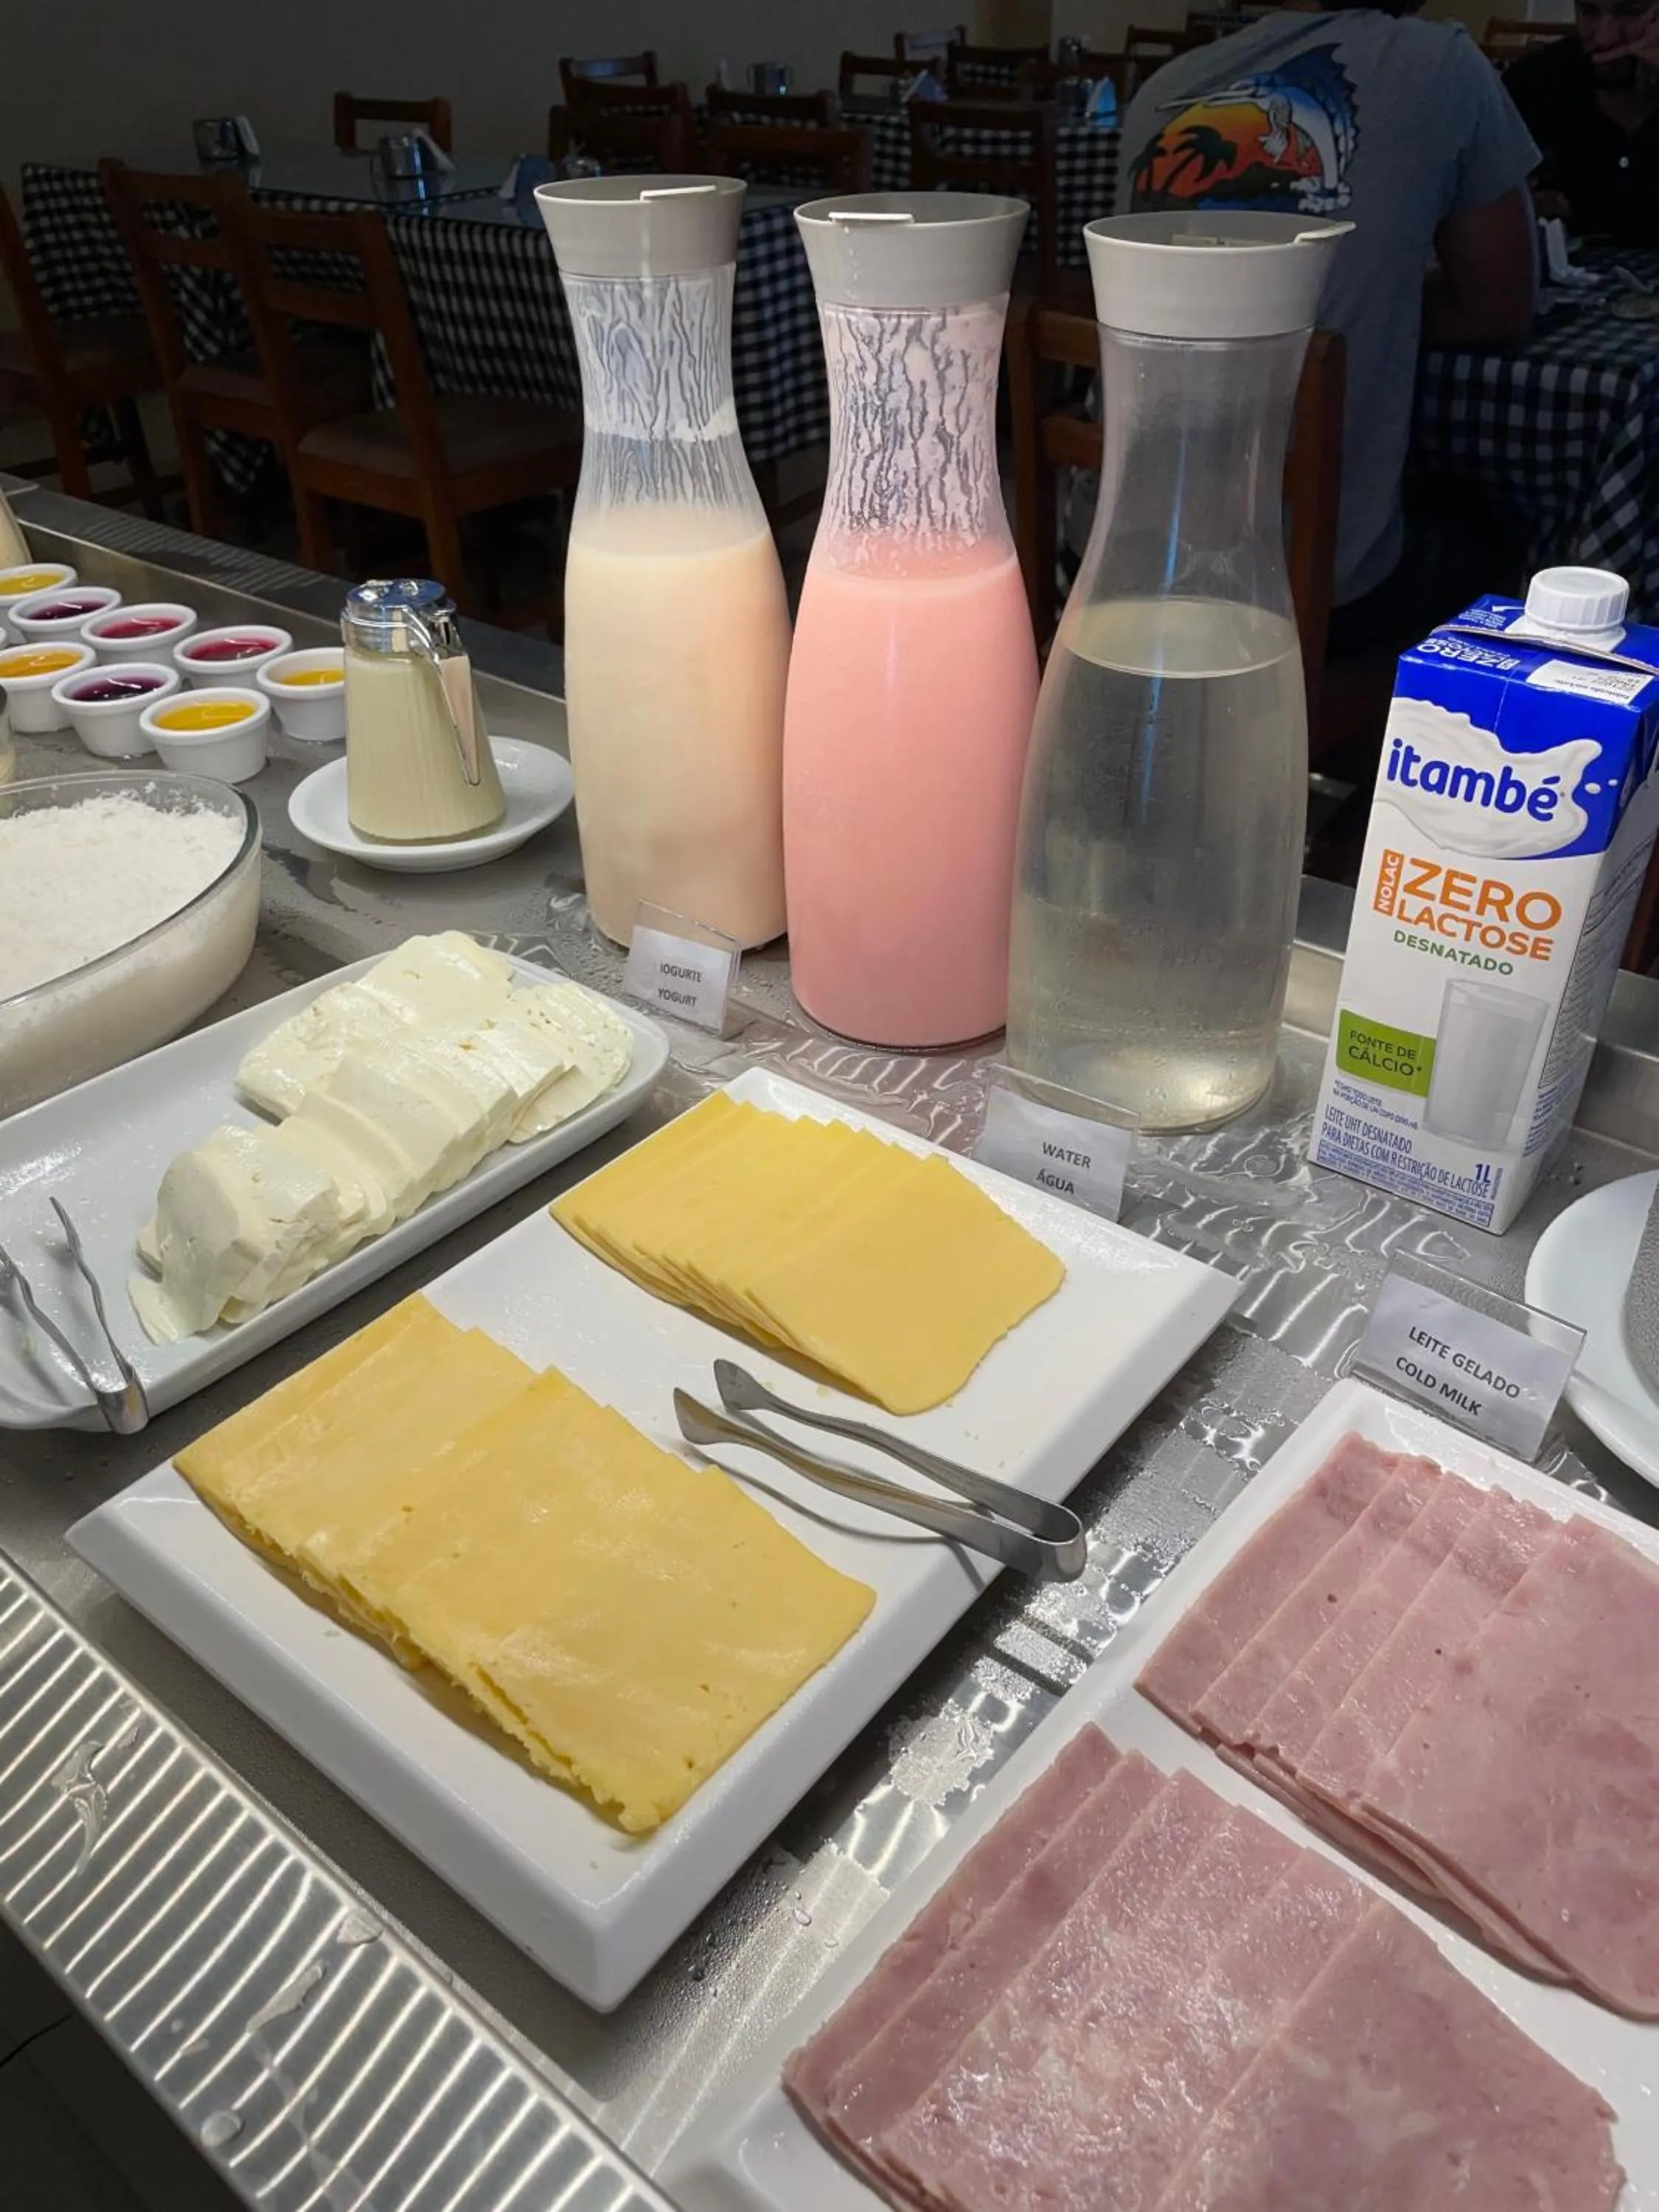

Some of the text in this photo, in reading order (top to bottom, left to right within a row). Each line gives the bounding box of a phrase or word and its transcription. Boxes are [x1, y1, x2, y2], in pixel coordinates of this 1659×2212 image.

[1386, 738, 1561, 821] itambé
[1377, 853, 1401, 911] NOLAC
[1403, 858, 1562, 931] ZERO
[1394, 929, 1514, 976] DESNATADO
[1397, 899, 1554, 961] LACTOSE
[658, 988, 697, 1007] YOGURT
[1349, 1030, 1416, 1059] FONTE DE
[1043, 1142, 1091, 1169] WATER
[1326, 1104, 1345, 1127] LEITE
[1363, 1121, 1412, 1154] DESNATADO
[1035, 1168, 1074, 1194] ÁGUA
[1321, 1121, 1340, 1144] PARA
[1342, 1132, 1370, 1155] DIETAS
[1371, 1144, 1390, 1163] COM
[1438, 1169, 1450, 1186] DE
[1450, 1173, 1491, 1198] LACTOSE
[1475, 1164, 1491, 1183] 1L
[1396, 1356, 1482, 1416] COLD MILK
[1408, 1326, 1521, 1399] LEITE GELADO
